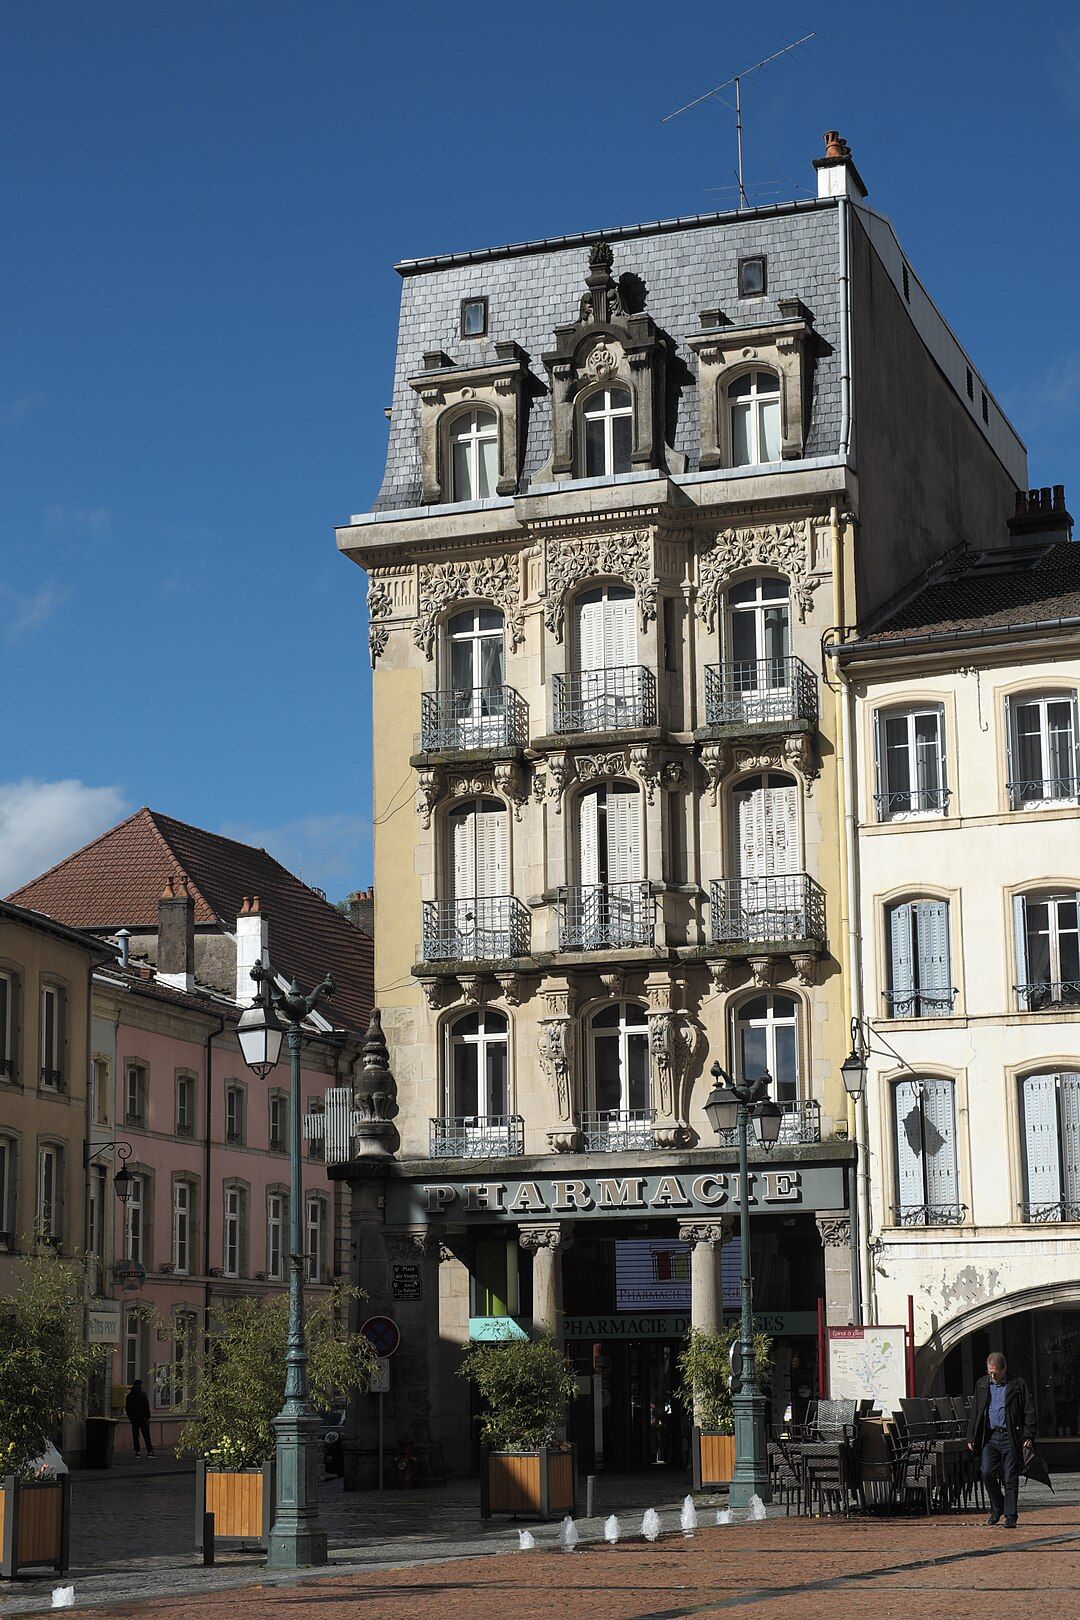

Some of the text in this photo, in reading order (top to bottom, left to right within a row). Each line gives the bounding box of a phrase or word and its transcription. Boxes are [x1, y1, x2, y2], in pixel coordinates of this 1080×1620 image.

[423, 1171, 800, 1213] PHARMACIE
[564, 1317, 666, 1335] PHARMACIE
[852, 1329, 864, 1337] pied
